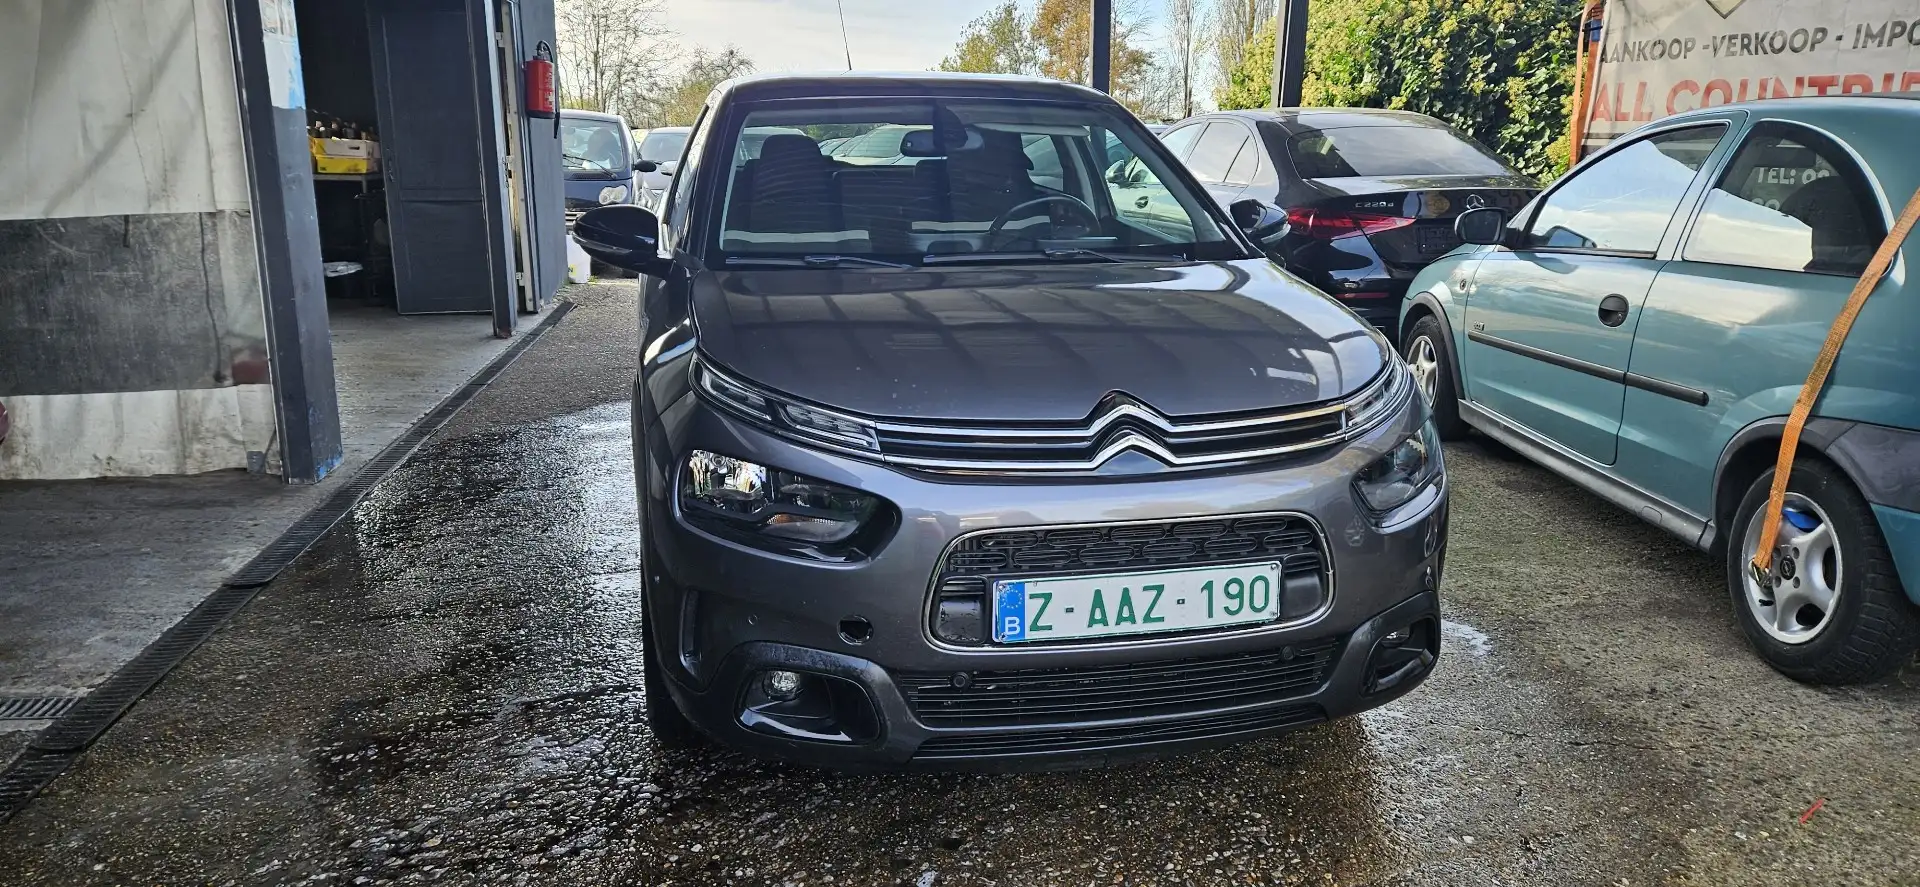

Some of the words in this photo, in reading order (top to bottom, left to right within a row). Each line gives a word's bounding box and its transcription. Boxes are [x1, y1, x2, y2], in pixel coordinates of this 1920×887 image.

[1600, 38, 1697, 63] AANKOOP
[1592, 81, 1653, 122] ALL
[1004, 615, 1021, 636] B
